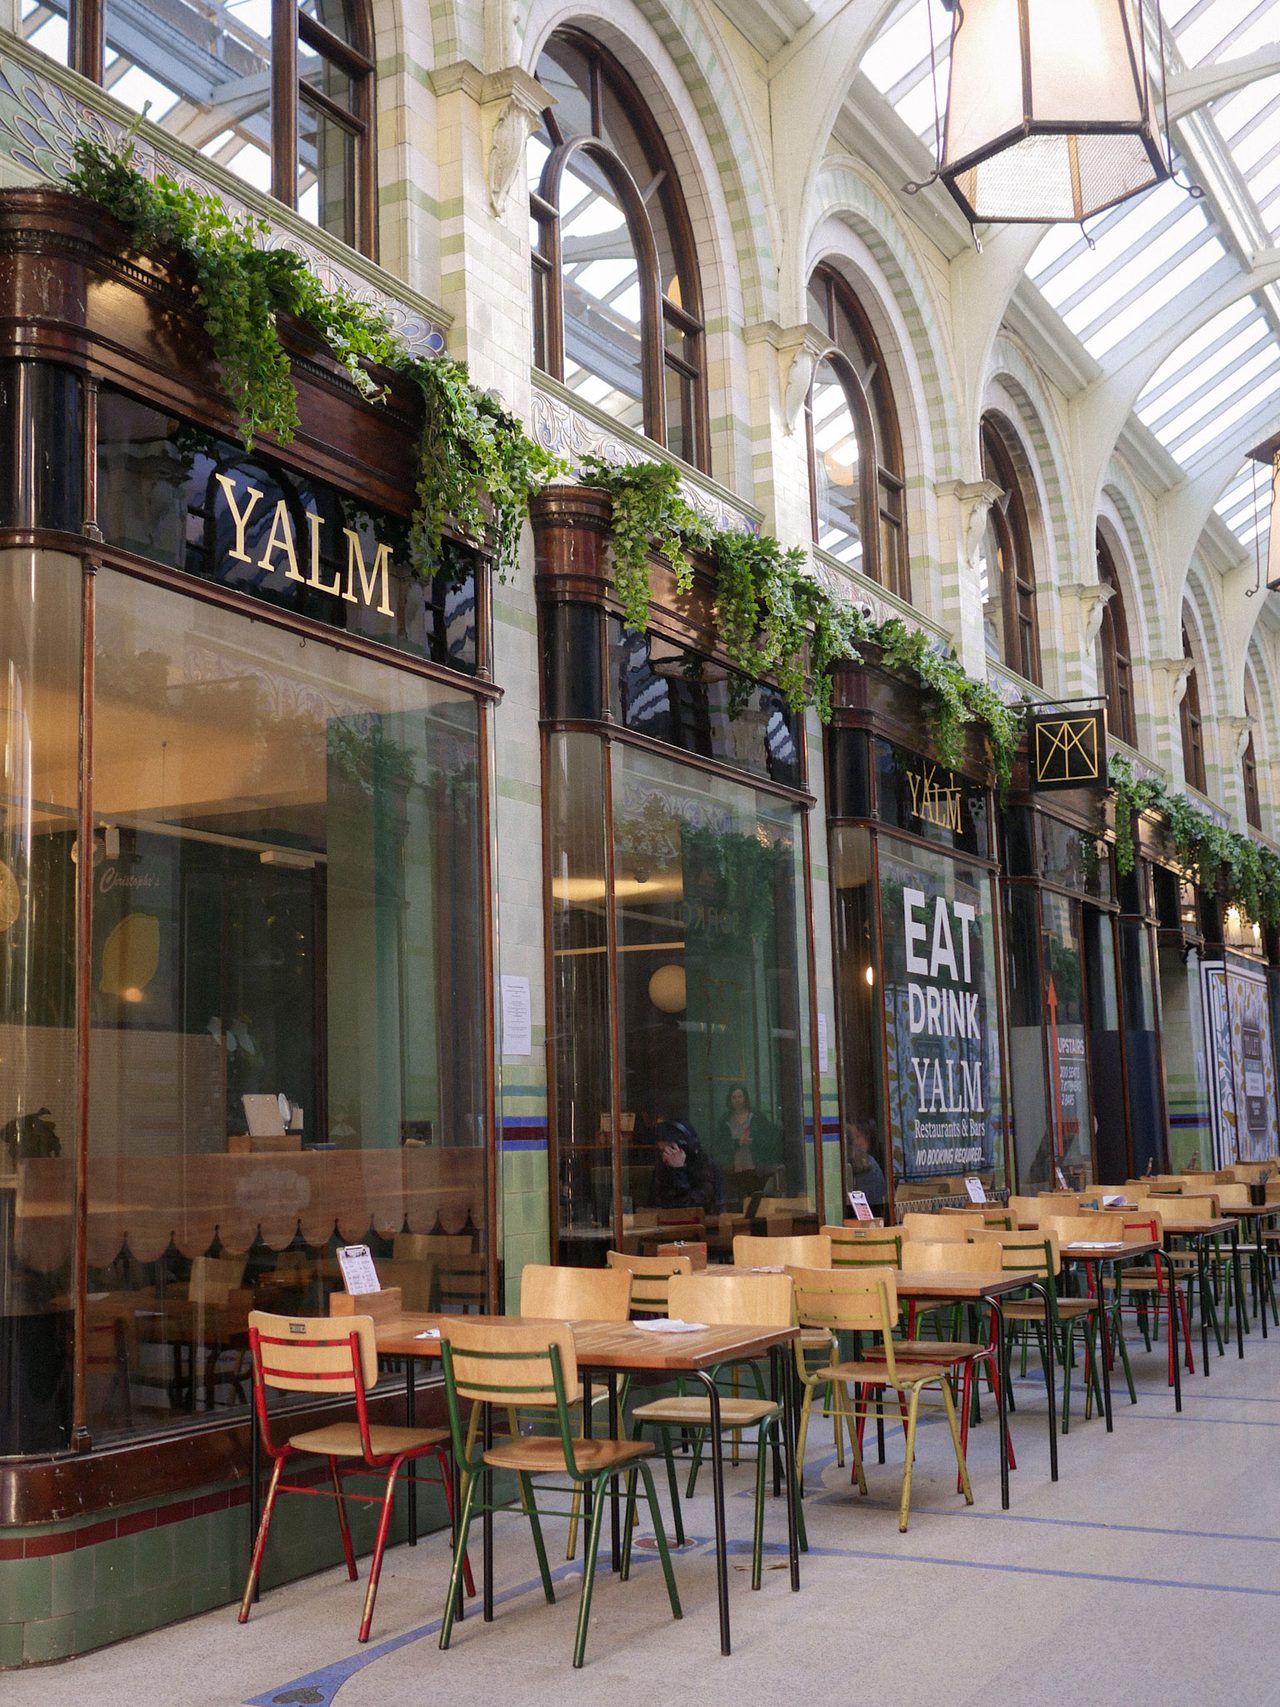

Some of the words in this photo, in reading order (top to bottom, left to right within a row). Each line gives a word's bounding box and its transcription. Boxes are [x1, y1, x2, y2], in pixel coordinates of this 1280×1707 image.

[215, 473, 395, 617] YALM
[906, 771, 963, 834] YALM
[903, 887, 976, 983] EAT
[908, 983, 981, 1040] DRINK
[1057, 1037, 1085, 1055] UPSTAIRS
[911, 1057, 984, 1113] YALM
[914, 1119, 961, 1139] Restaurants
[961, 1118, 969, 1138] &
[969, 1118, 985, 1137] Bars
[915, 1150, 927, 1167] NO
[927, 1148, 953, 1166] BOOKING
